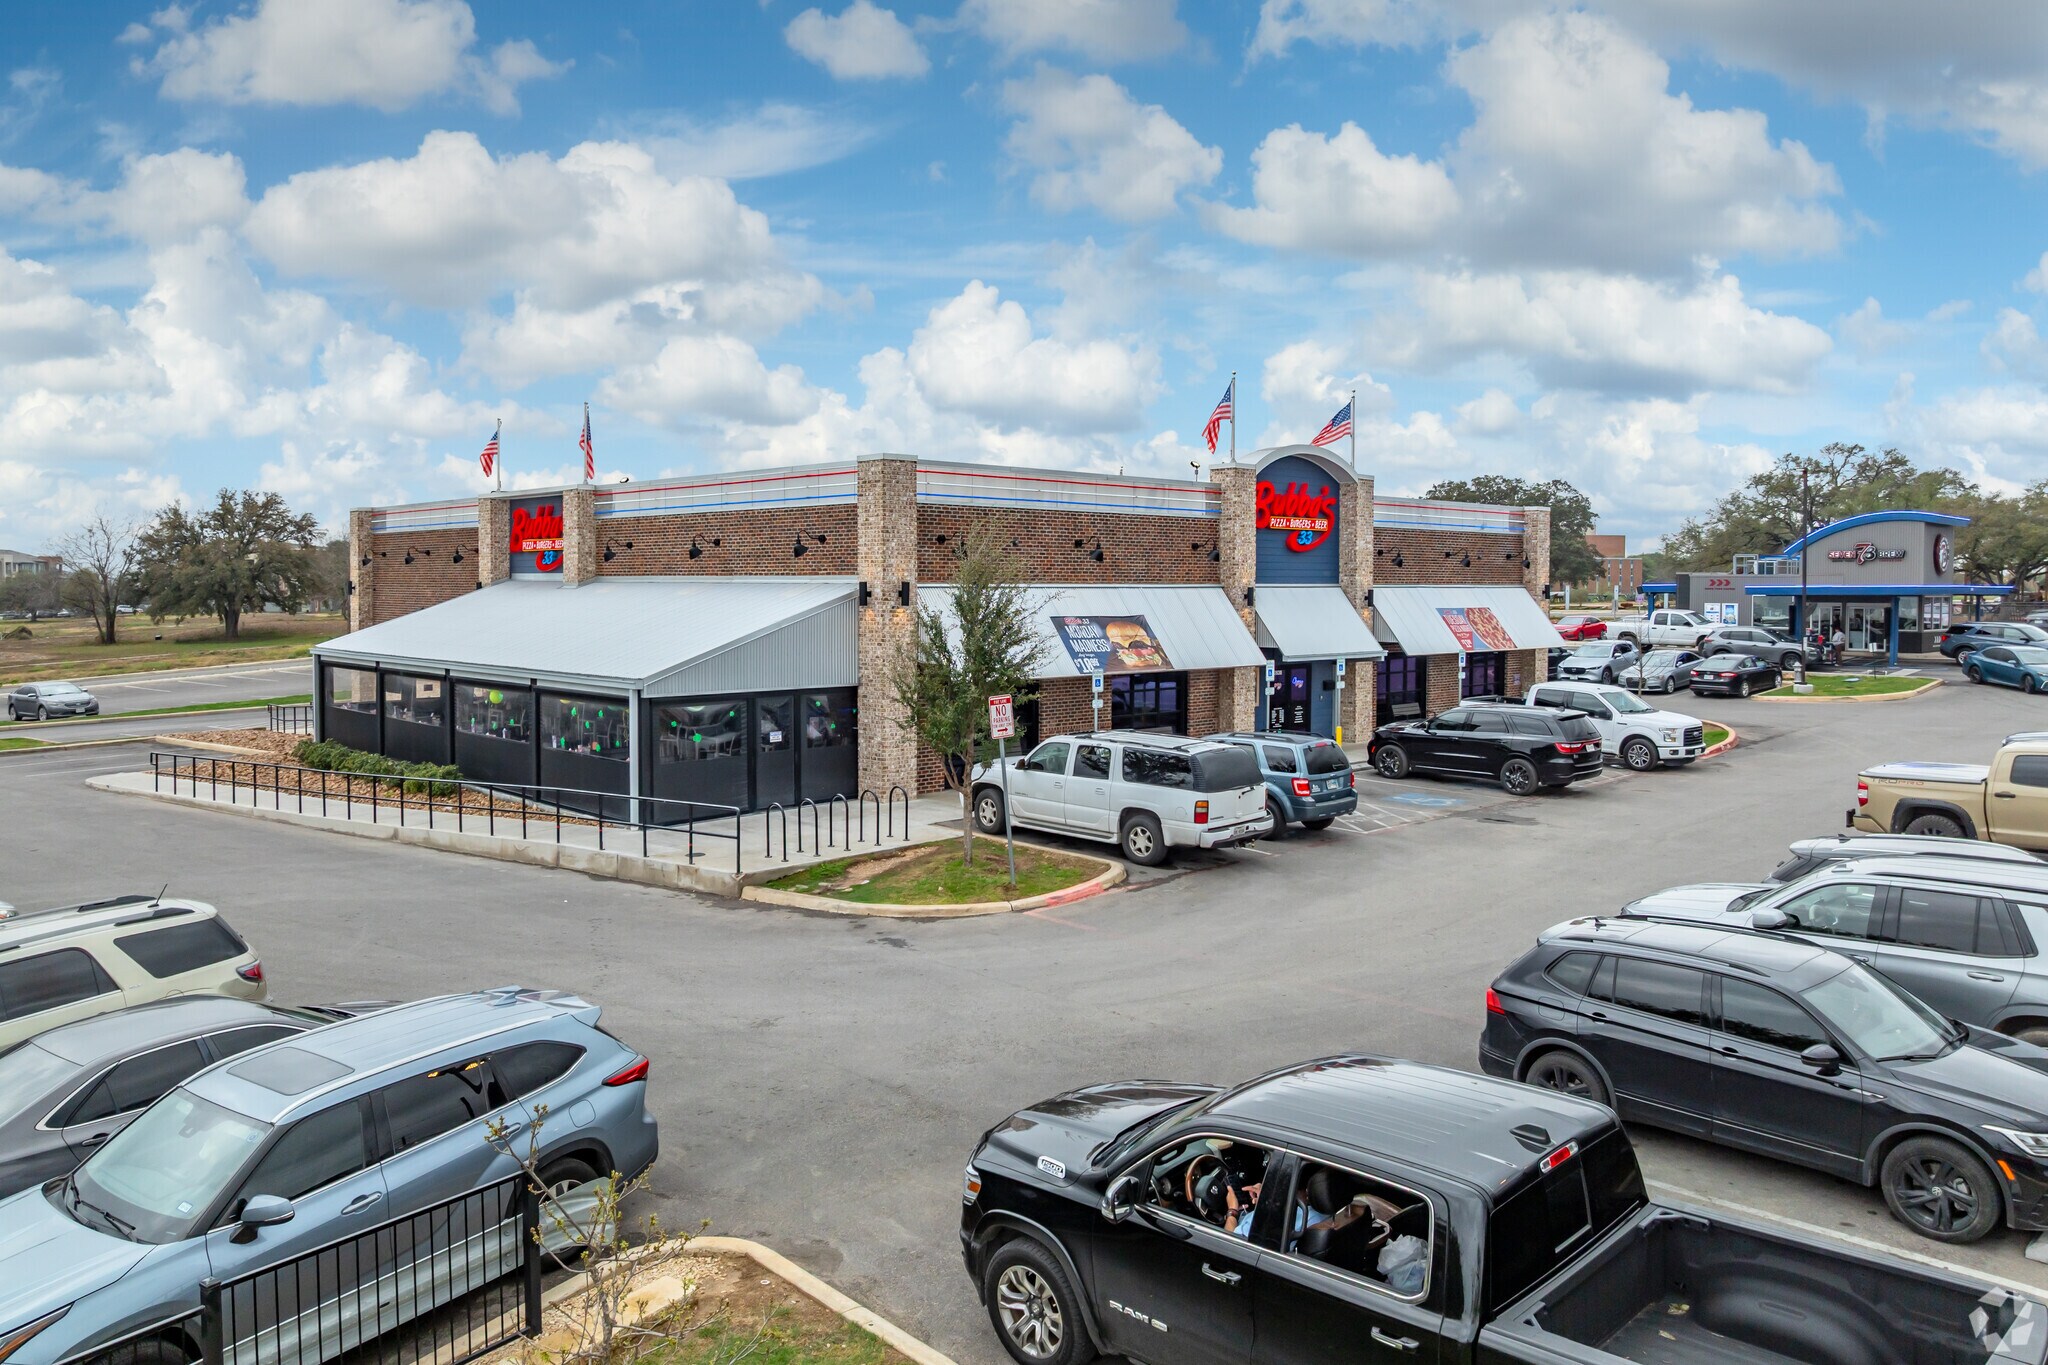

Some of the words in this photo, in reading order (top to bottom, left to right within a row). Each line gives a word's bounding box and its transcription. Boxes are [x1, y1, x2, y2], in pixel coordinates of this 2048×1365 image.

[1256, 480, 1337, 553] Bubba's
[1270, 518, 1287, 527] PIZZA
[1289, 518, 1311, 529] BURGERS
[1314, 520, 1327, 530] BEER
[1297, 530, 1313, 545] 33
[522, 541, 534, 550] PIZZA
[542, 550, 555, 565] 33
[1828, 550, 1857, 560] SEVEN
[1878, 550, 1906, 560] BREW
[1064, 625, 1100, 639] MONDAY
[1069, 638, 1111, 653] MADNESS
[995, 704, 1007, 717] NO
[993, 715, 1011, 723] PARKING
[1871, 777, 1898, 785] TRD
[1109, 1299, 1150, 1324] RAM
